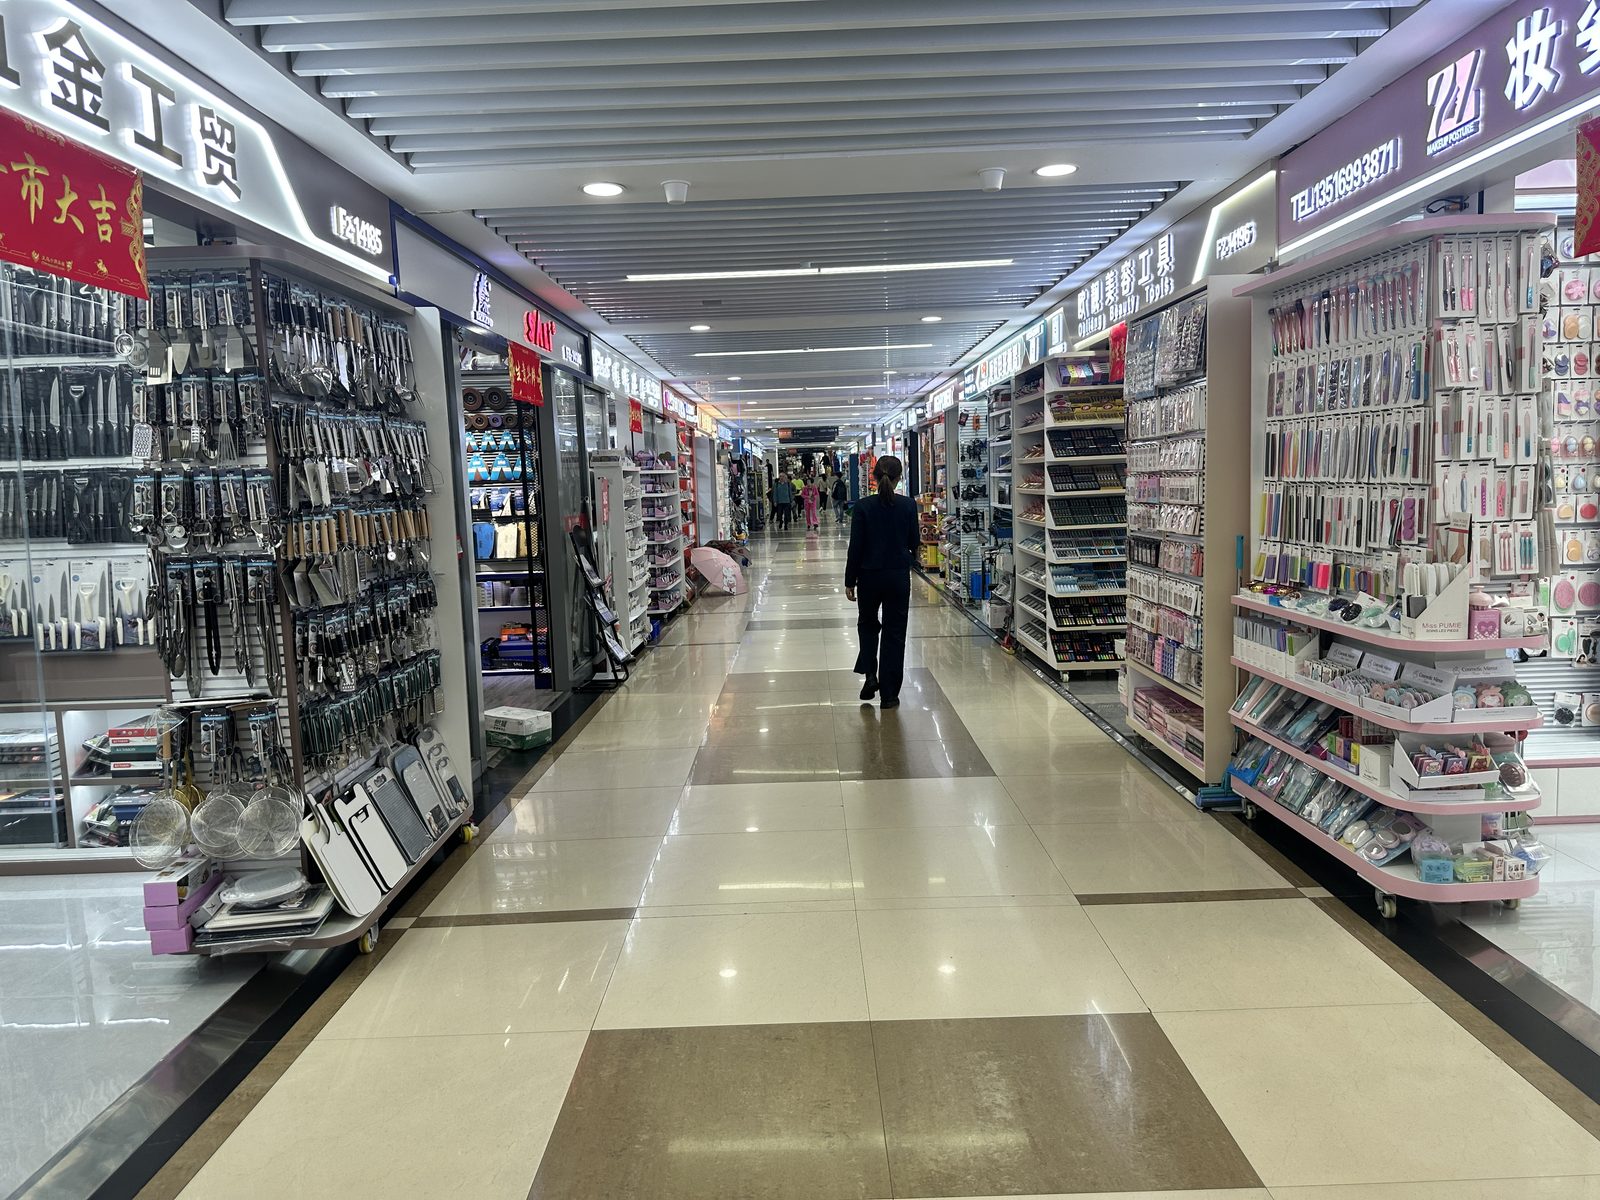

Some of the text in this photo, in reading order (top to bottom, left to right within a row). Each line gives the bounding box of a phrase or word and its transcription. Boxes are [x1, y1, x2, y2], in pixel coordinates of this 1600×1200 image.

[1427, 123, 1475, 156] MAKEUP POSTURE
[0, 152, 117, 243] 市大吉
[1145, 277, 1173, 303] Tools
